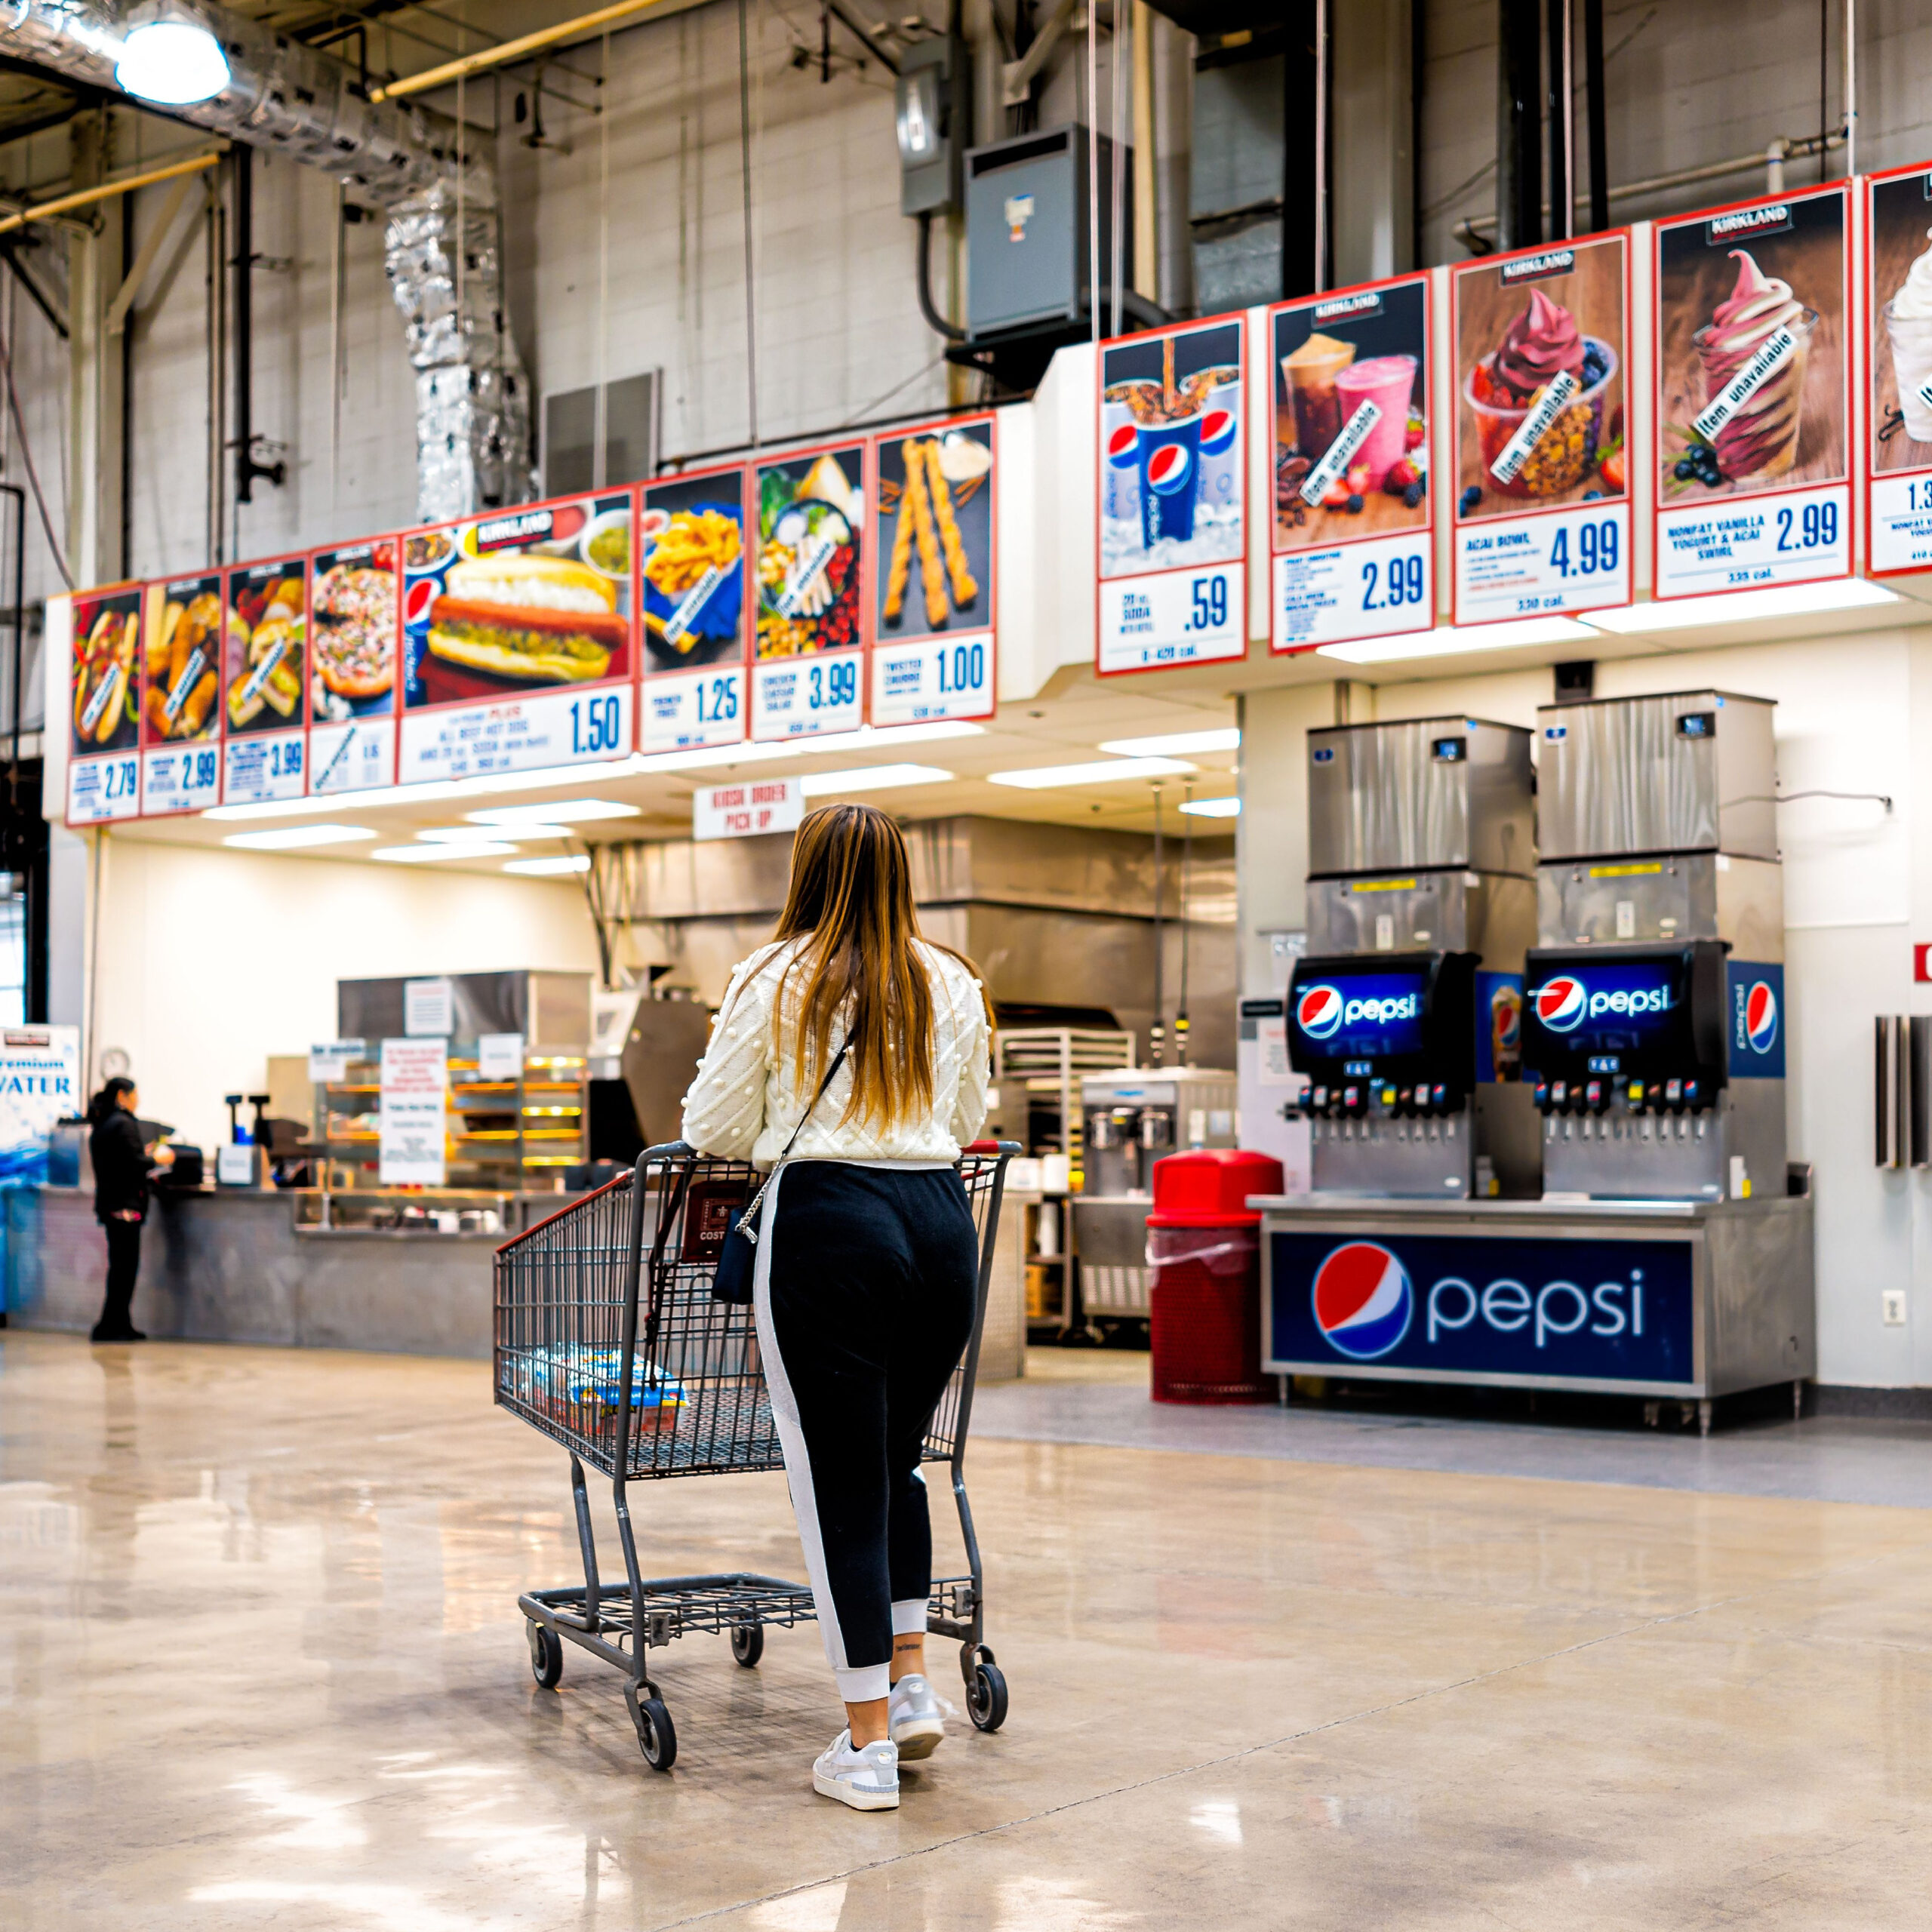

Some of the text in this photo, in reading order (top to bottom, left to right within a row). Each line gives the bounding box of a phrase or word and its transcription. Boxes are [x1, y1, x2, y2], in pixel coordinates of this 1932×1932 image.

[1712, 205, 1788, 234] KIRKLAND
[1503, 251, 1574, 278] KIRKLAND
[1697, 334, 1792, 435] Item unavailable
[1496, 378, 1574, 482] Item unavailable
[1304, 407, 1376, 503] Item unavailable
[1497, 532, 1531, 546] BOWL
[1717, 515, 1764, 531] VANILLA
[1777, 500, 1838, 552] 2.99
[1549, 518, 1619, 578] 4.99
[1184, 574, 1227, 631] .59
[1362, 554, 1423, 611] 2.99
[810, 661, 856, 709] 3.99
[937, 643, 983, 693] 1.00
[697, 676, 737, 723] 1.25
[570, 696, 620, 754] 1.50
[105, 761, 136, 798] 2.79
[182, 750, 216, 789] 2.99
[1344, 993, 1417, 1026] pepsi
[1589, 983, 1670, 1018] pepsi
[1427, 1269, 1644, 1348] pepsi
